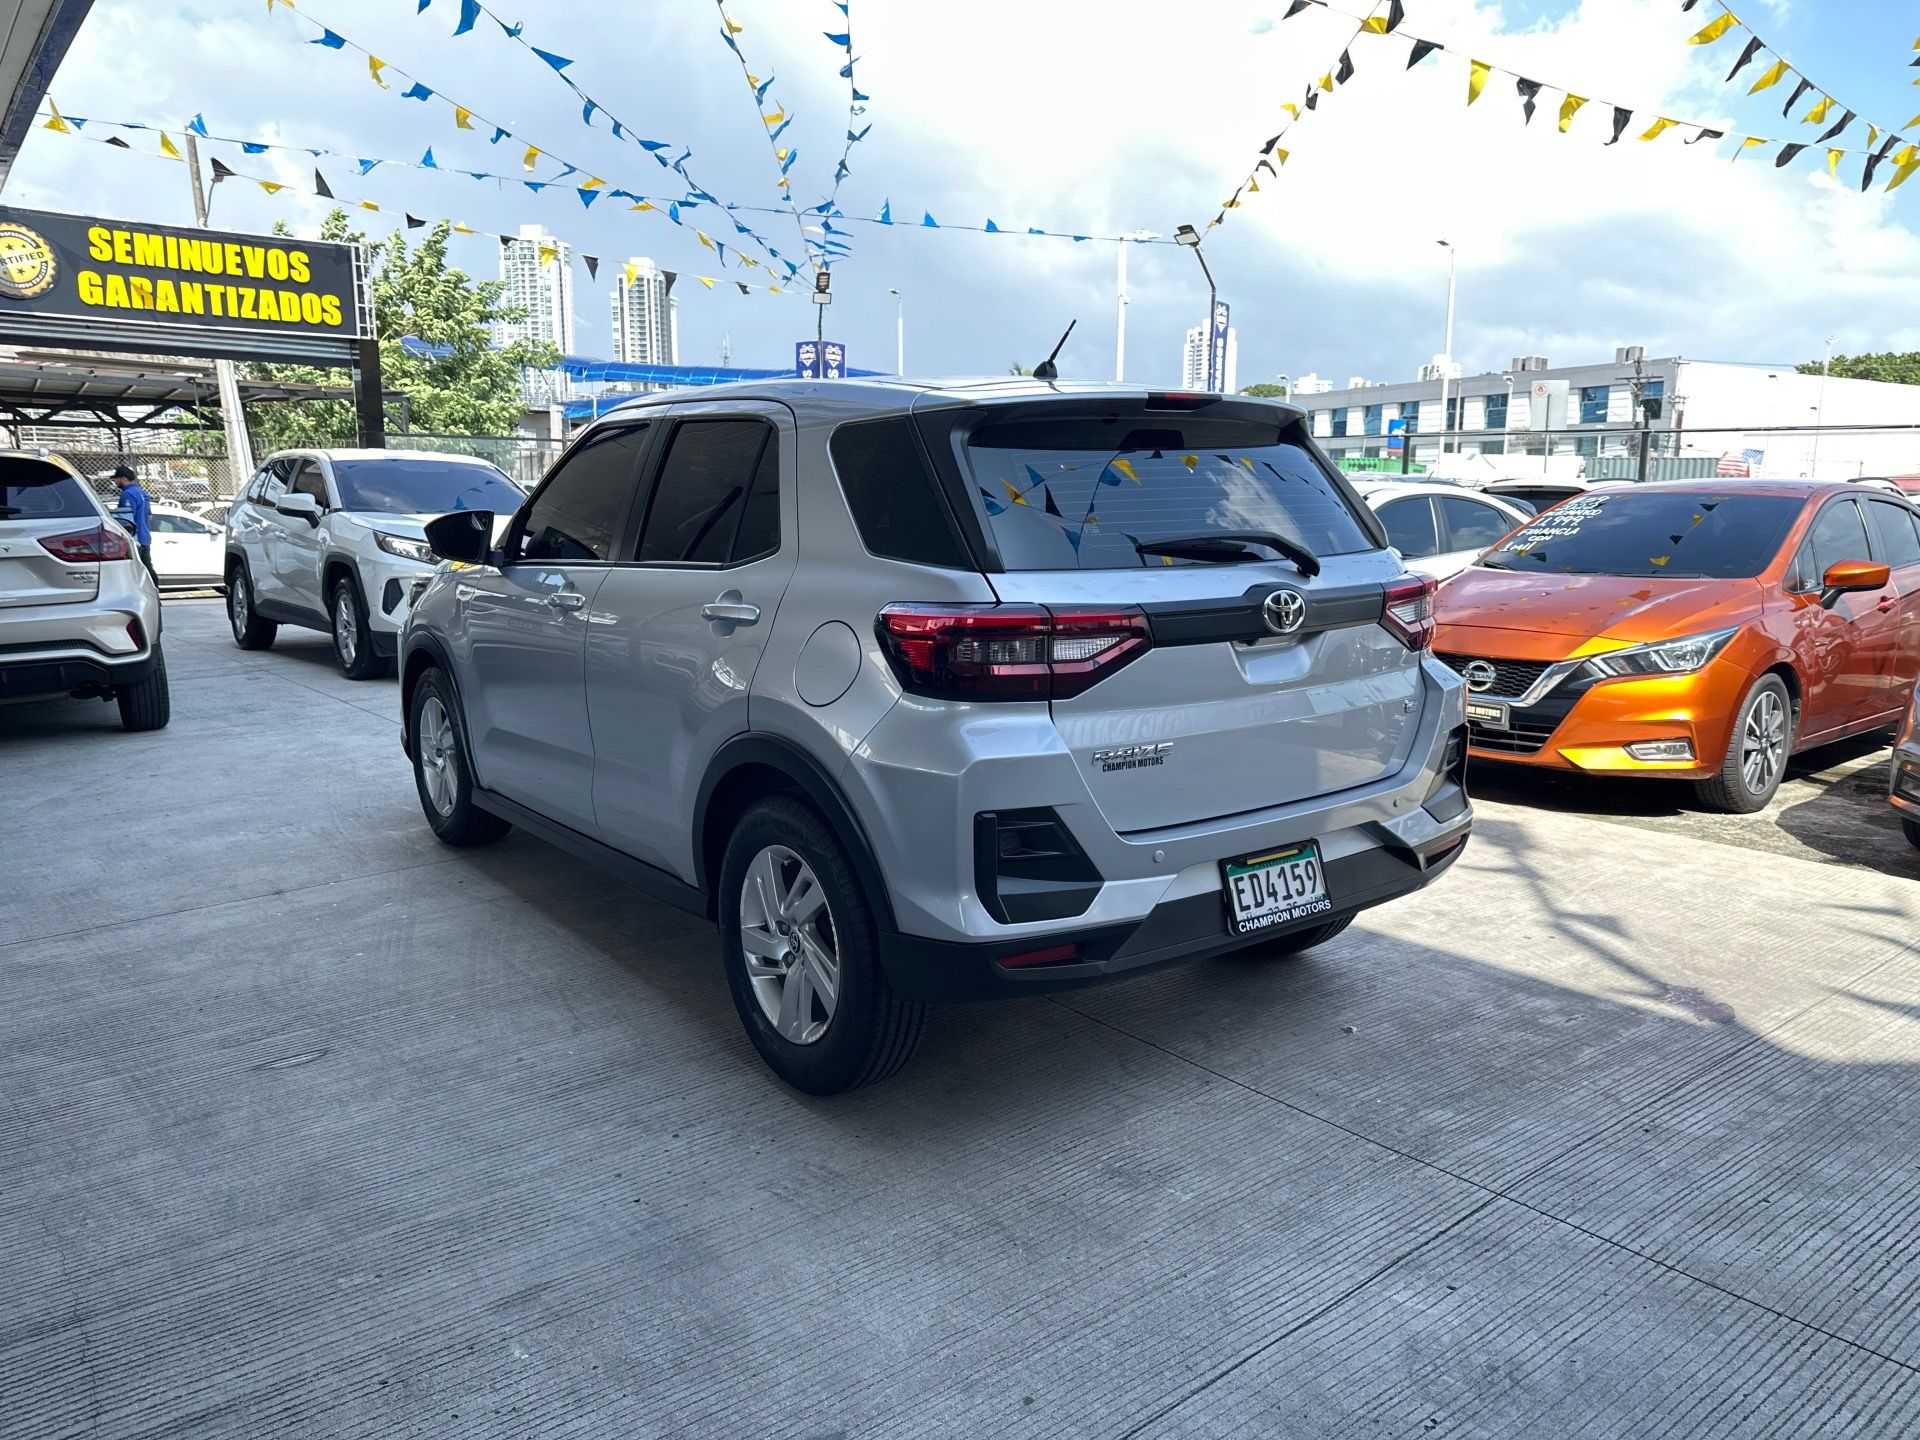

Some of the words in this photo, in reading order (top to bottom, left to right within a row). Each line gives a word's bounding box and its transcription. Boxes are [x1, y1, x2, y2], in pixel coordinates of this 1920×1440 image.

[88, 226, 311, 284] SEMINUEVOS
[77, 270, 342, 327] GARANTIZADOS
[1517, 527, 1580, 536] FINANCIA
[1476, 706, 1501, 717] MOTORS
[1102, 760, 1137, 773] CHAMPION
[1137, 756, 1164, 768] MOTORS
[1233, 860, 1318, 912] ED4159
[1238, 908, 1290, 933] CHAMPION
[1291, 899, 1331, 918] MOTORS
